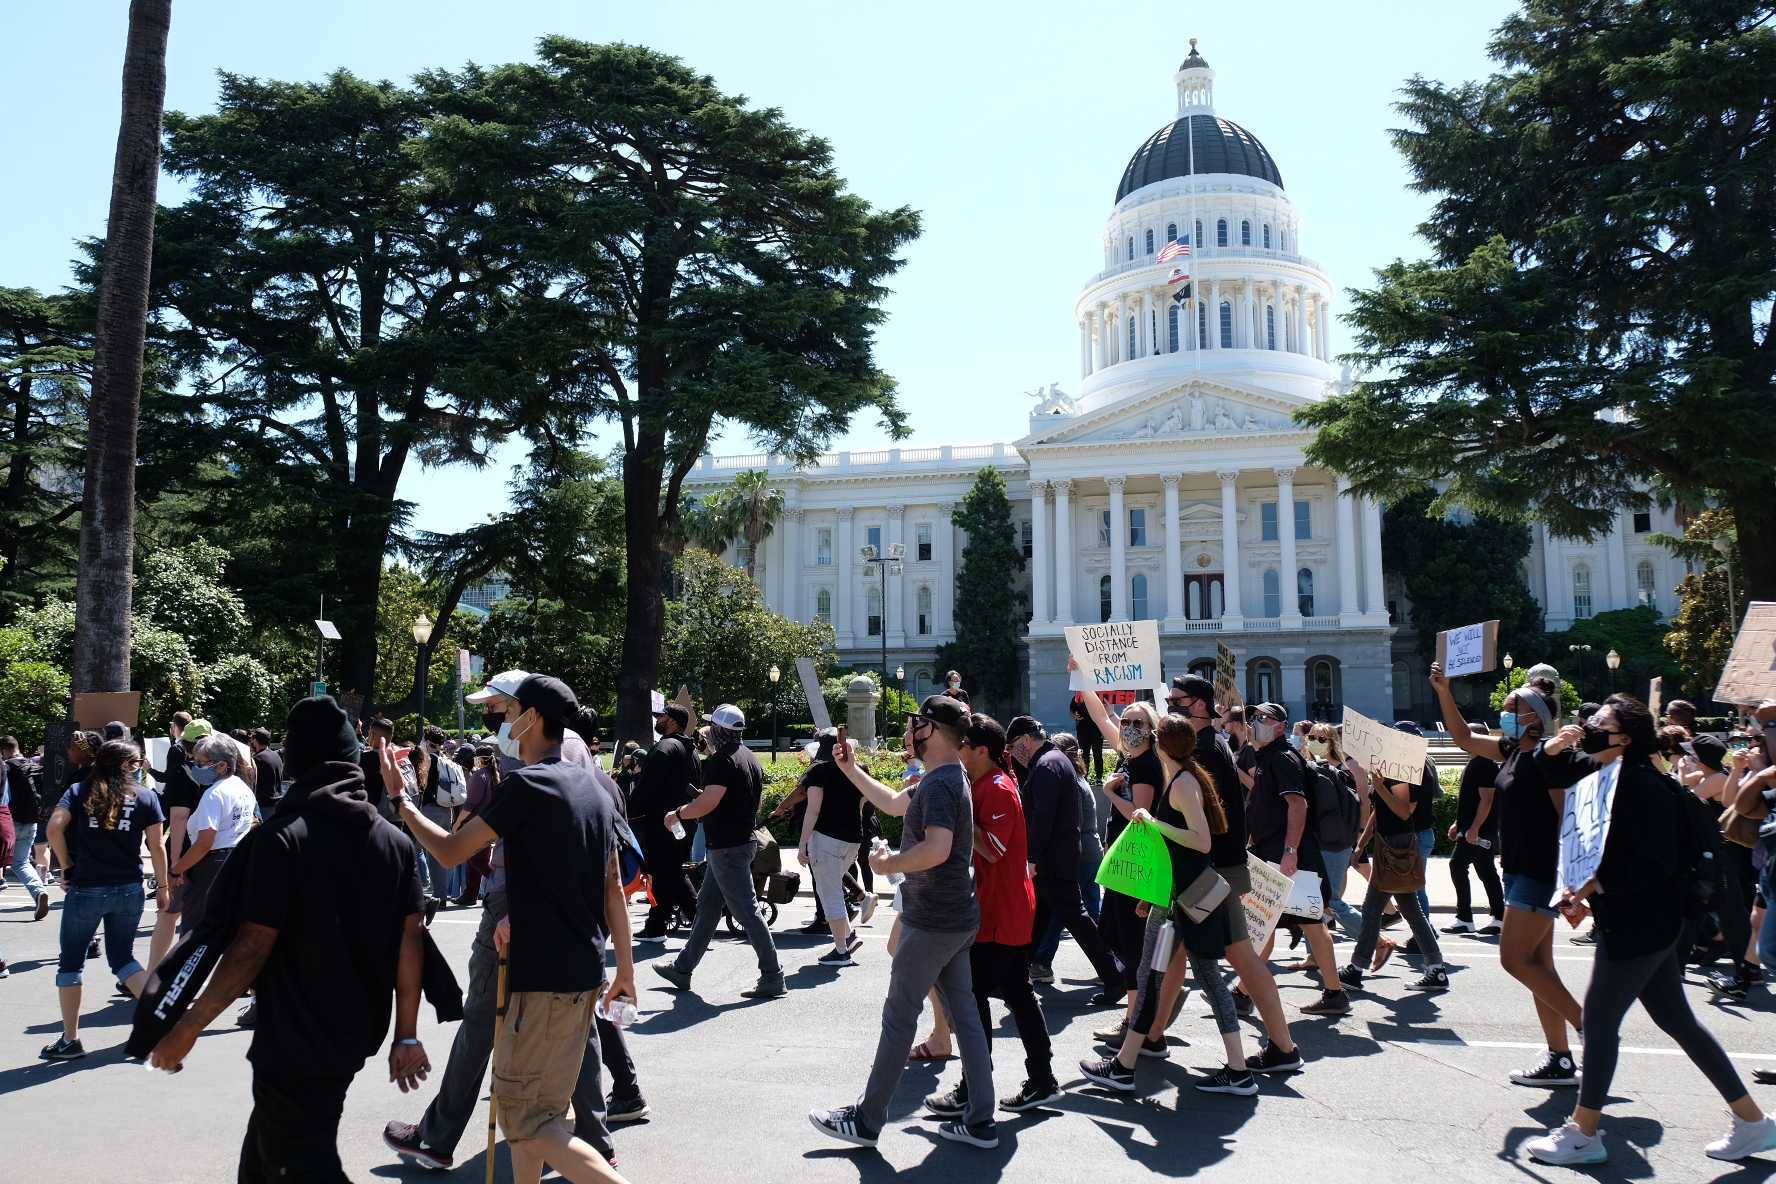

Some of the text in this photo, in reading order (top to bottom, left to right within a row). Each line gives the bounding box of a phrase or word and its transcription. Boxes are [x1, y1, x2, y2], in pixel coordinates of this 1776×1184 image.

[1082, 623, 1132, 641] SOCIALLY
[1449, 628, 1481, 649] WE WILL
[1085, 636, 1139, 653] DISTANCE
[1099, 652, 1127, 665] FROM
[1094, 663, 1142, 684] RACISM
